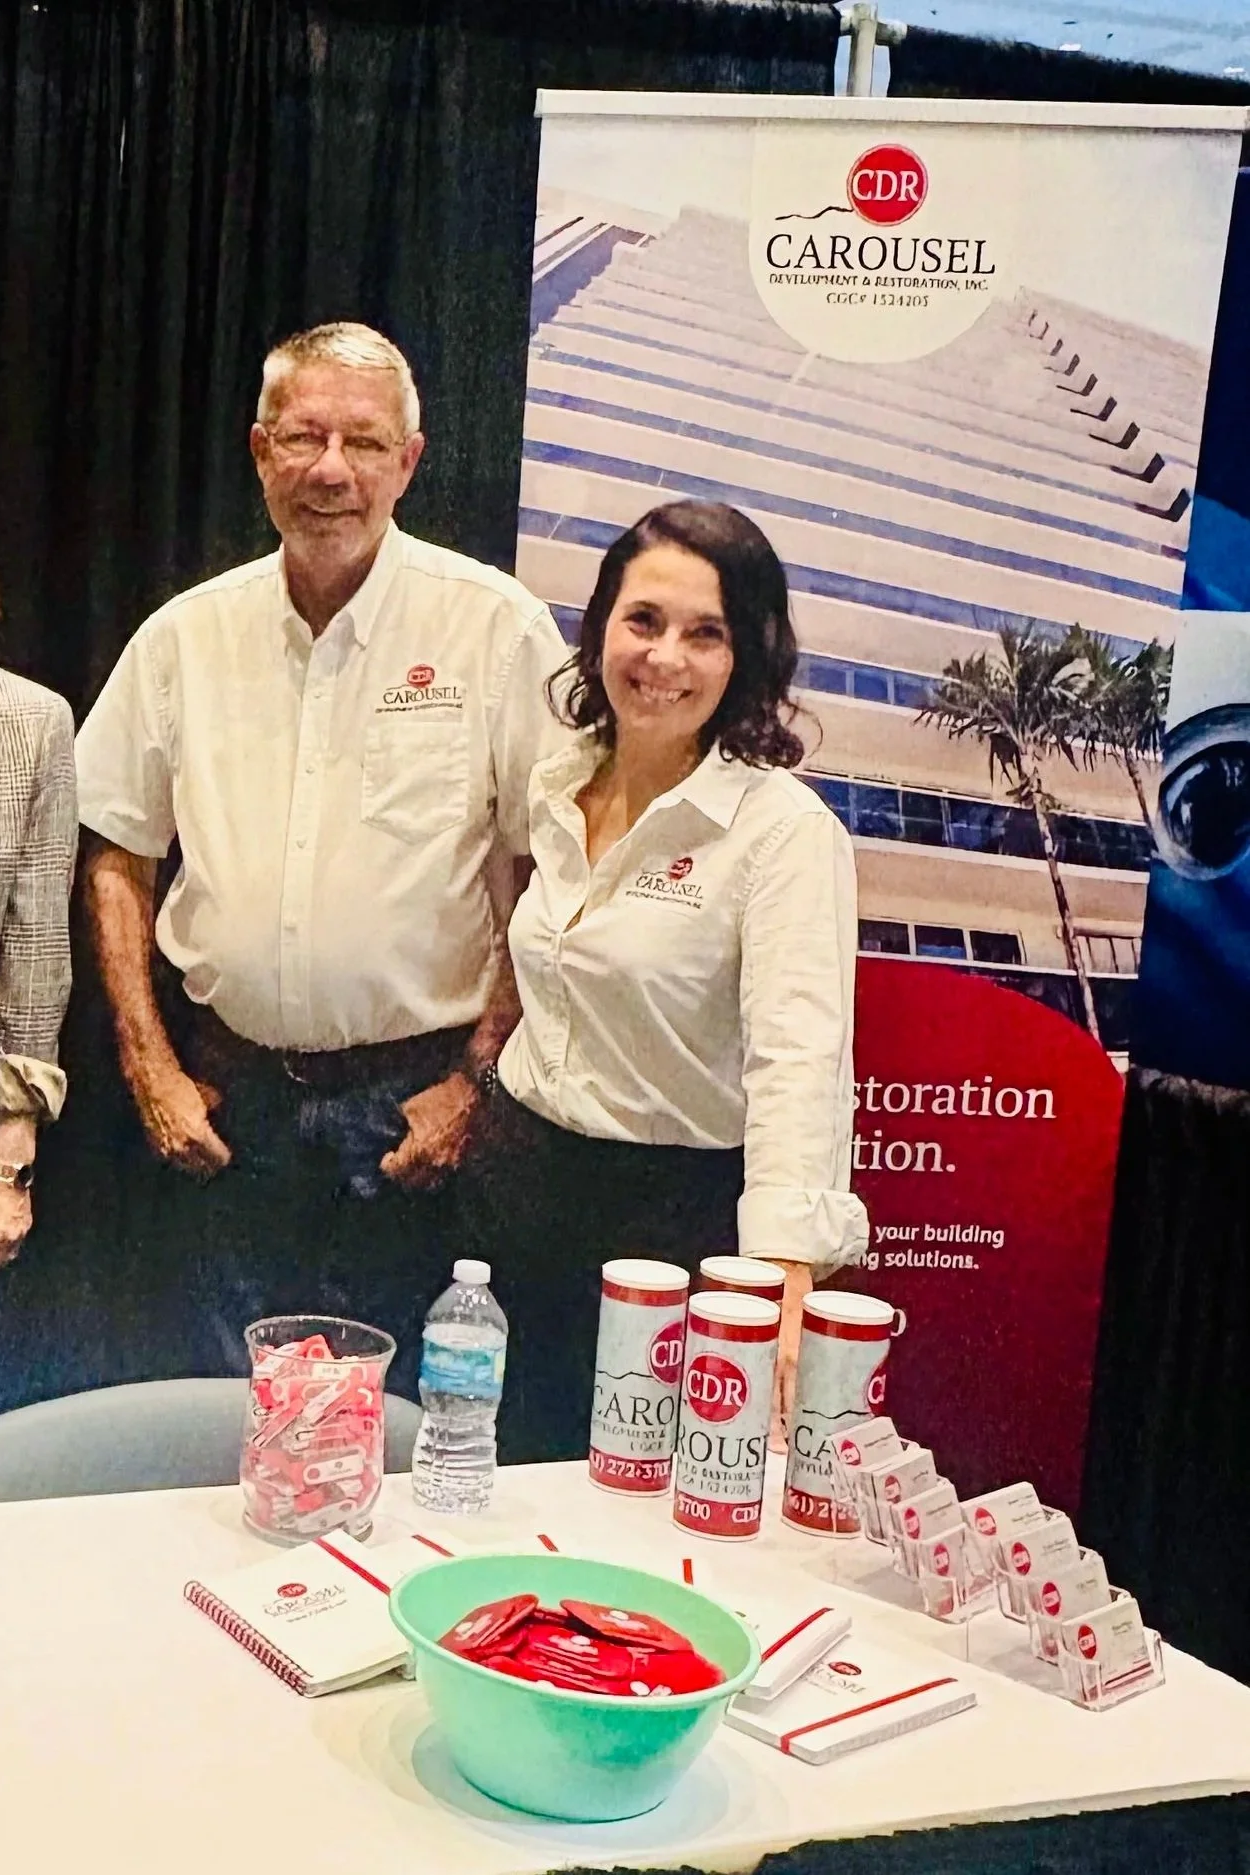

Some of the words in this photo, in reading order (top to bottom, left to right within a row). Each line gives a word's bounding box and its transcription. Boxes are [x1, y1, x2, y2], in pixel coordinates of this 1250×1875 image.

[852, 168, 920, 202] CDR
[766, 233, 996, 275] CAROUSEL
[875, 1225, 921, 1244] your
[924, 1223, 1006, 1249] building
[884, 1248, 980, 1270] solutions.
[686, 1369, 744, 1408] CDR
